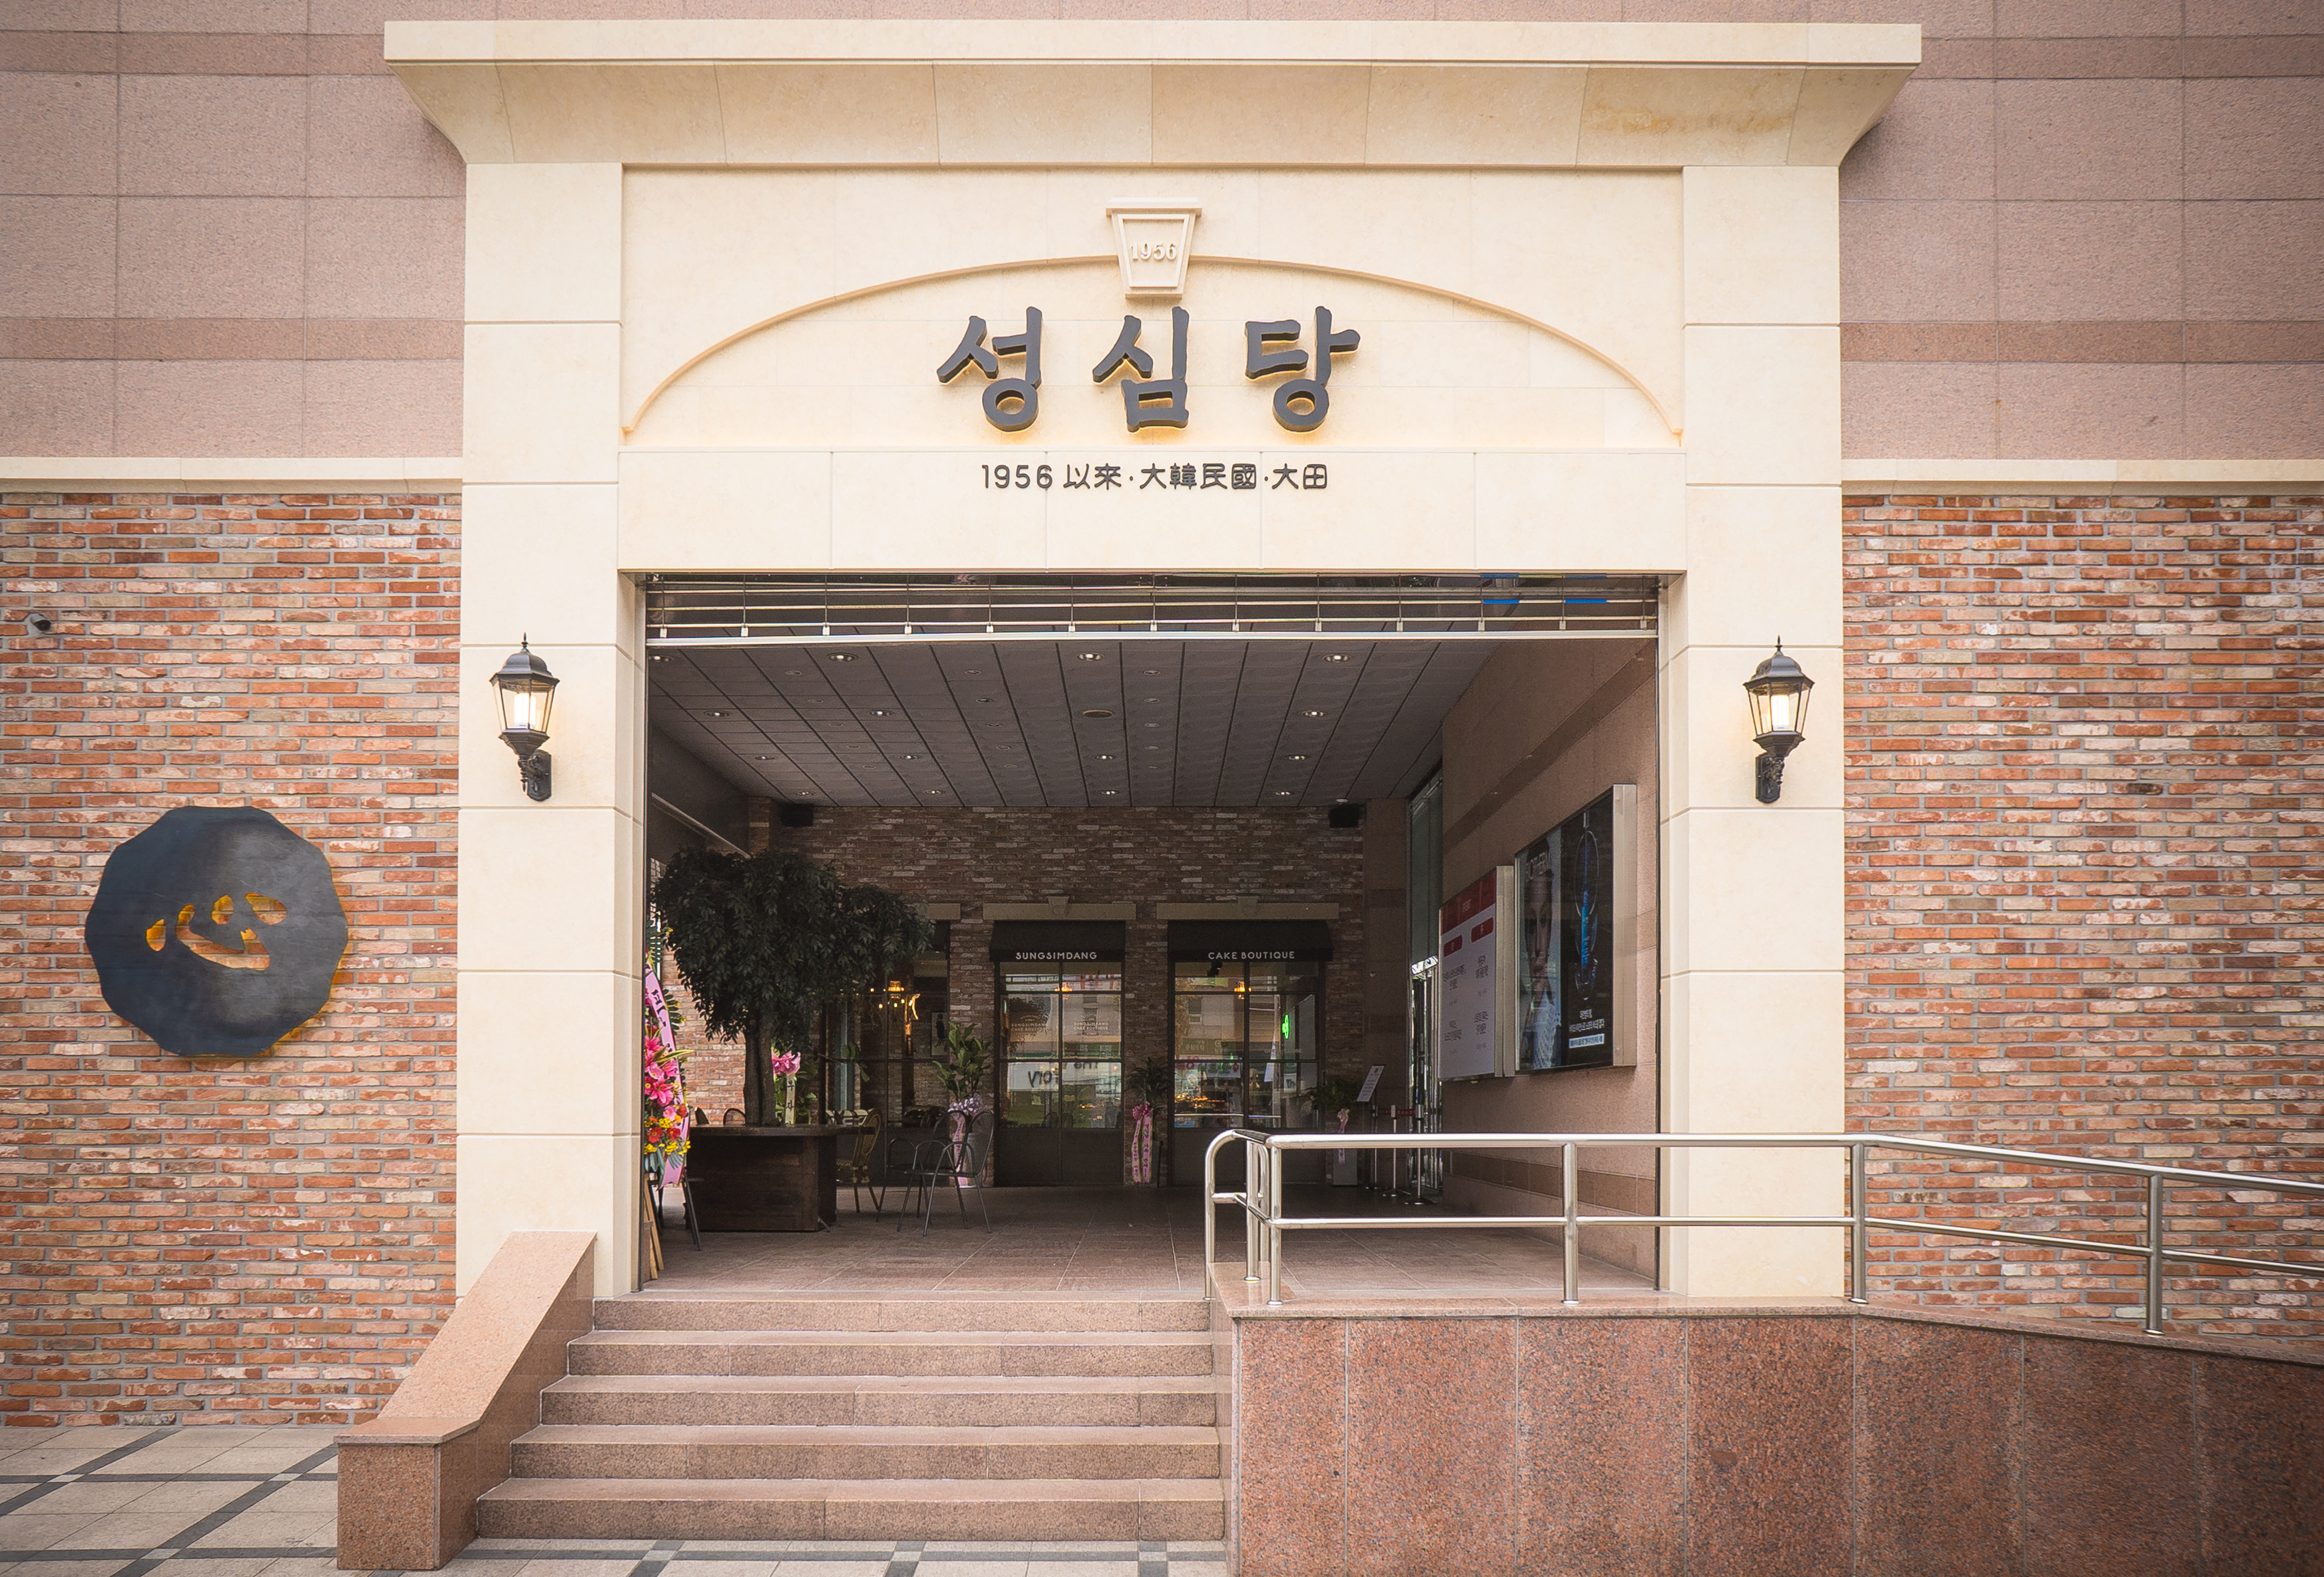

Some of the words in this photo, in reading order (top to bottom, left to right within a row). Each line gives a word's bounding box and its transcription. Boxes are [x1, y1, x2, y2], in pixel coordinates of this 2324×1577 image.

[1130, 242, 1178, 261] 1956
[936, 306, 1361, 433] 성심당
[982, 464, 1053, 489] 1956
[1015, 951, 1097, 960] SUNGSIMDANG
[1208, 951, 1238, 960] CAKE
[1241, 951, 1295, 960] BOUTIQUE
